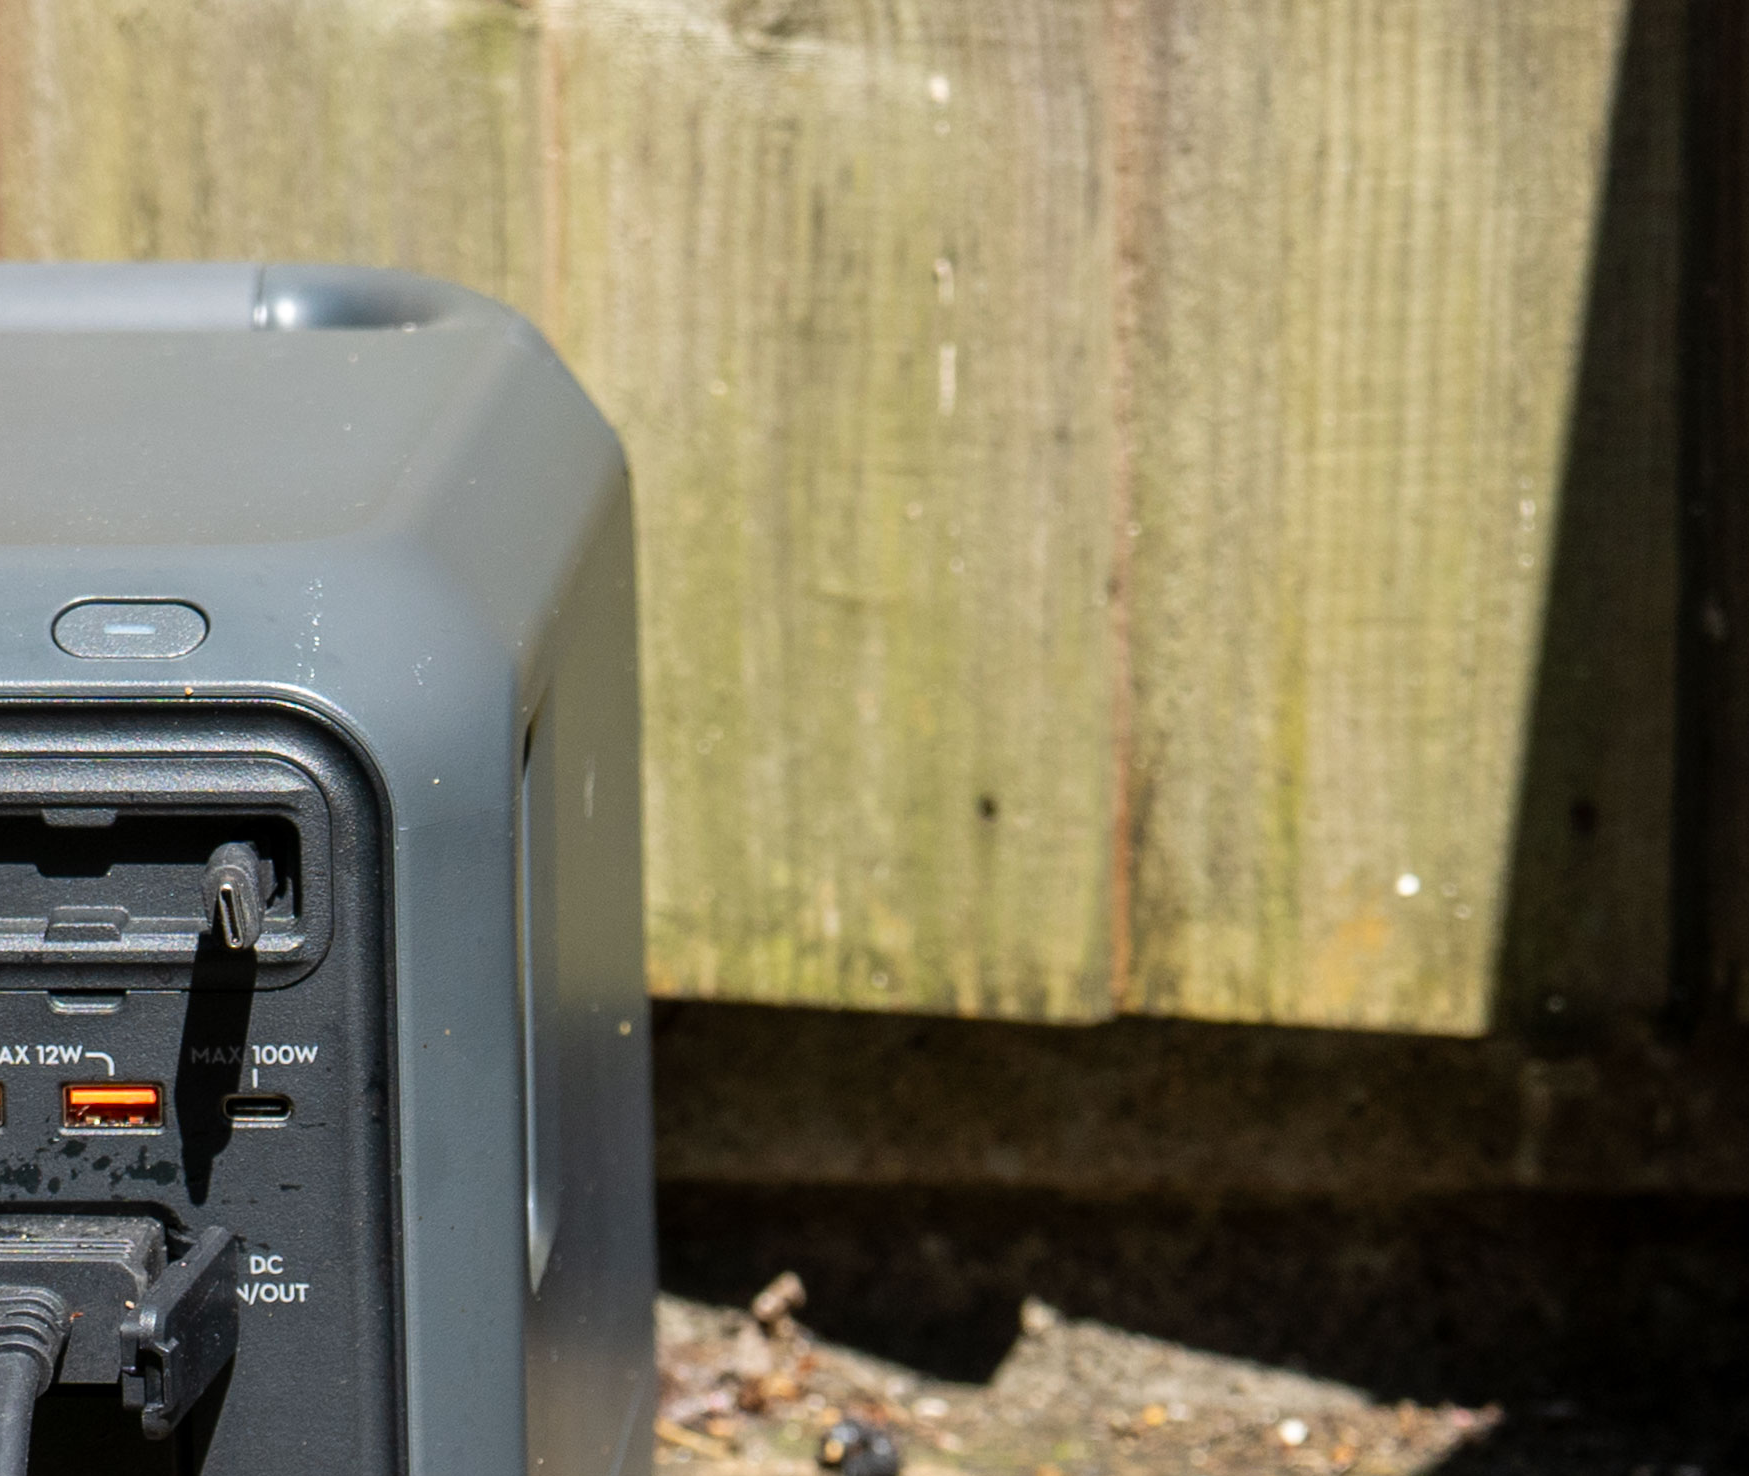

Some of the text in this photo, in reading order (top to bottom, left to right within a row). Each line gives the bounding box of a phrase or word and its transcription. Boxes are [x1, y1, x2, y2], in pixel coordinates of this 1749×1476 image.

[35, 1045, 83, 1065] 12W
[191, 1044, 319, 1065] MAX 100W
[249, 1254, 284, 1275] DC
[236, 1282, 310, 1306] N/OUT
